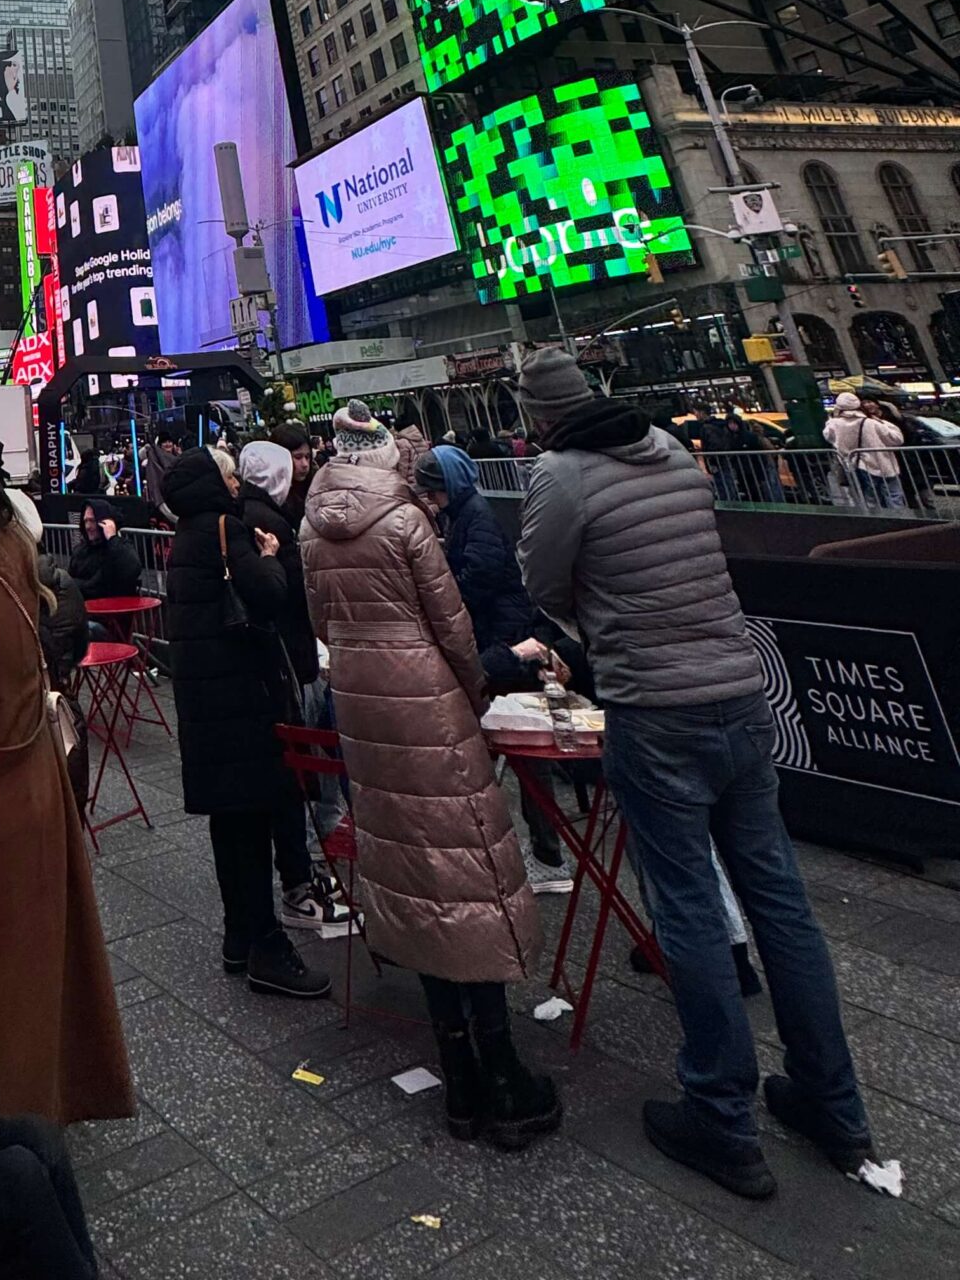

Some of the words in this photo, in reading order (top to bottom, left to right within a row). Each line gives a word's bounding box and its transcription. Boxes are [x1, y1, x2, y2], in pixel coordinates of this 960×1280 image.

[799, 107, 863, 125] MILLER
[873, 108, 952, 126] BUILDING
[22, 145, 46, 160] SHOP
[344, 147, 415, 201] National
[357, 183, 408, 214] UNIVERSITY
[90, 252, 119, 267] Google
[92, 272, 105, 283] top
[106, 264, 153, 278] trending
[804, 656, 905, 693] TIMES
[807, 688, 932, 732] SQUARE
[827, 725, 936, 763] ALLIANCE
